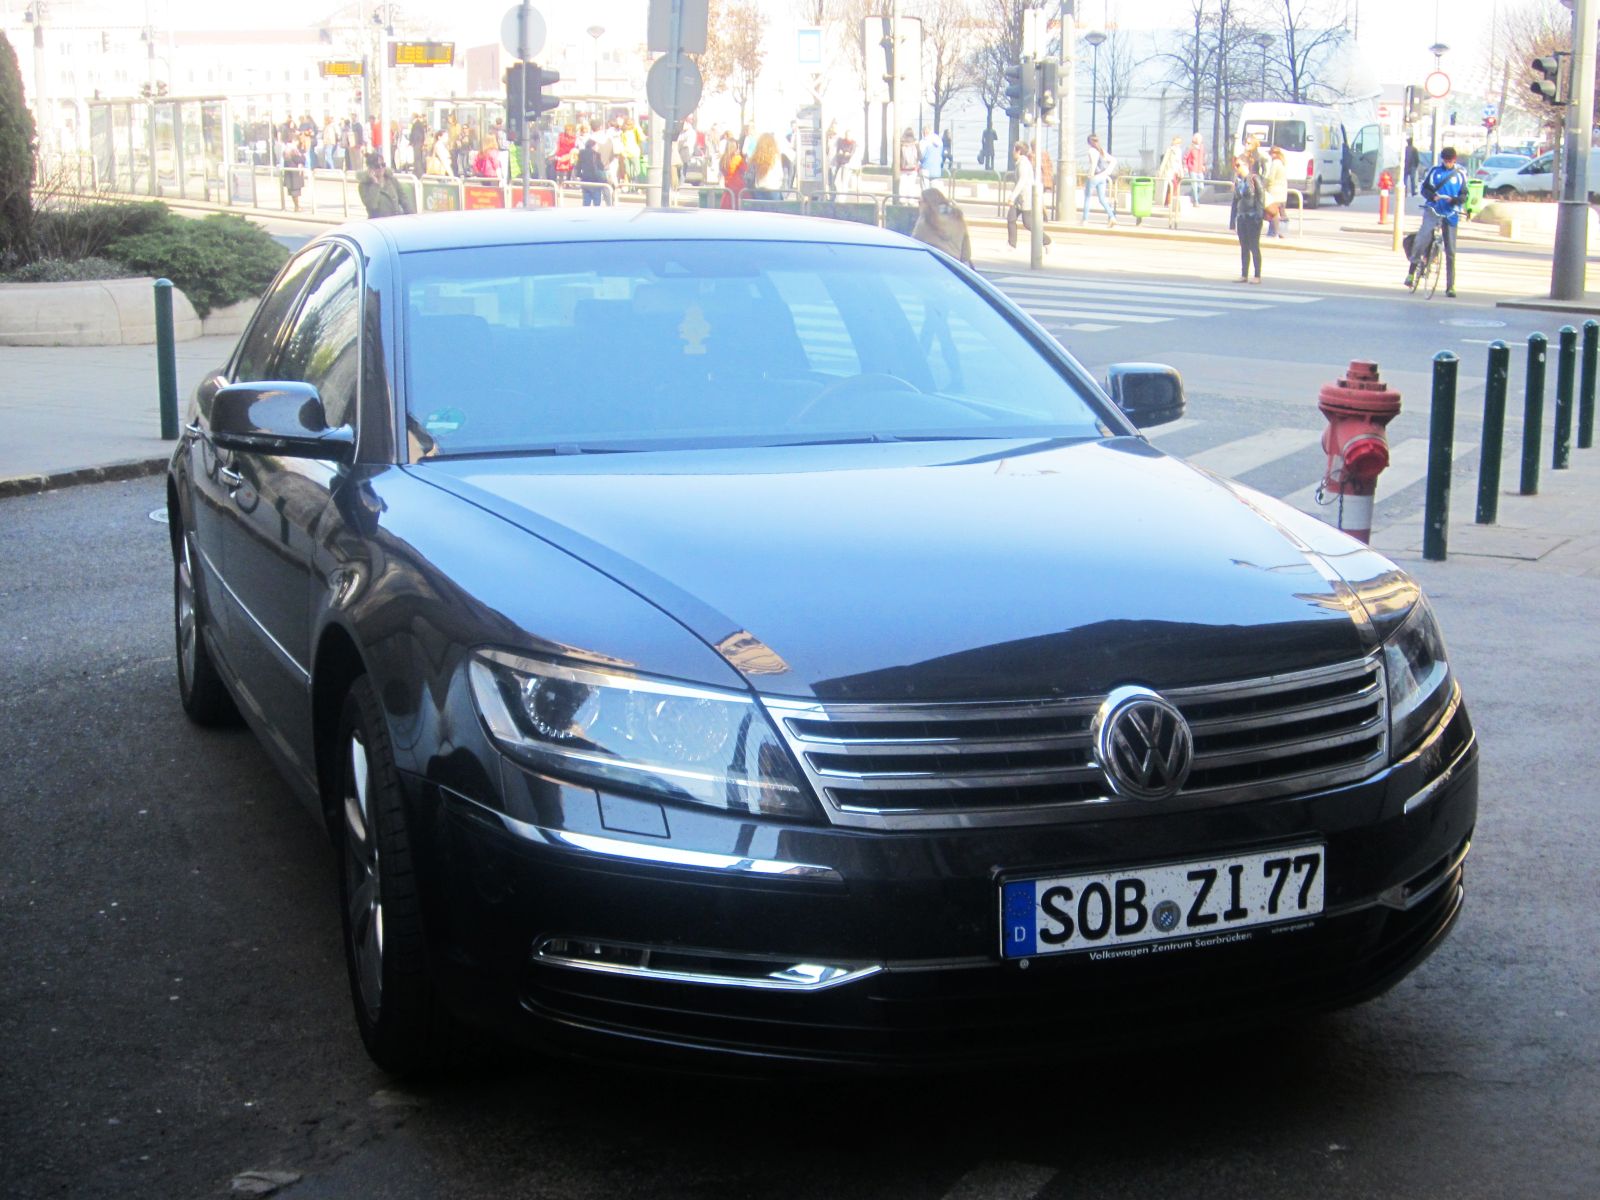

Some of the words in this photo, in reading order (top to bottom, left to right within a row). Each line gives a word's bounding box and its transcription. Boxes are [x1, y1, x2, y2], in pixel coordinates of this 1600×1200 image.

[1039, 878, 1148, 944] SOB
[1186, 865, 1248, 927] ZI
[1263, 853, 1320, 914] 77
[1014, 926, 1026, 942] D
[1089, 947, 1149, 961] Volkswagen
[1152, 940, 1193, 953] Zentrum
[1195, 932, 1253, 948] Saarbrücken
